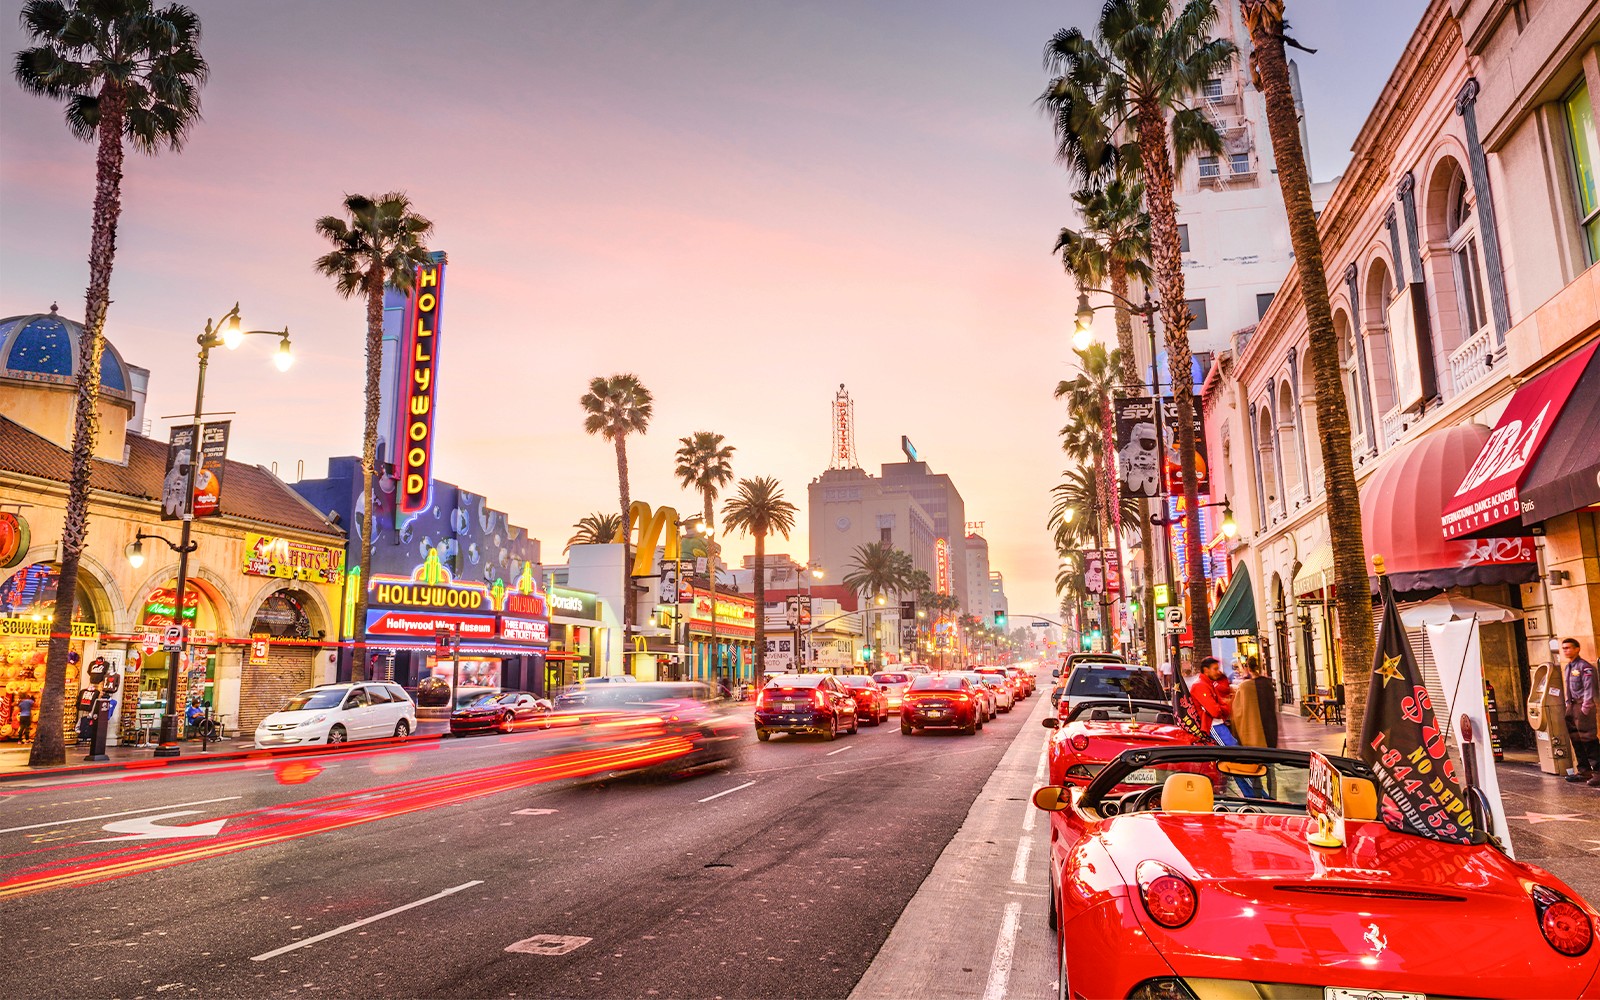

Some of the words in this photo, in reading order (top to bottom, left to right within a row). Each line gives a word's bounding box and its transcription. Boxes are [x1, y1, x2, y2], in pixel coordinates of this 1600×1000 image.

[407, 268, 437, 494] HOLLYWOOD
[175, 427, 217, 437] JOUNEY
[1441, 503, 1475, 526] INTERNATIONAL
[1474, 498, 1492, 513] DANCE
[1491, 487, 1517, 506] ACADEMY
[1521, 499, 1535, 513] Paris
[1442, 500, 1520, 538] HOLLYWOOD
[377, 583, 482, 609] HOLLYWOOD
[2, 620, 51, 636] SOUVENI
[386, 617, 434, 632] Hollywood
[435, 620, 455, 631] Wax
[504, 620, 519, 629] THREE
[504, 629, 516, 638] ONE
[516, 630, 530, 639] TICKET
[252, 641, 266, 657] $5
[1407, 745, 1433, 775] NO
